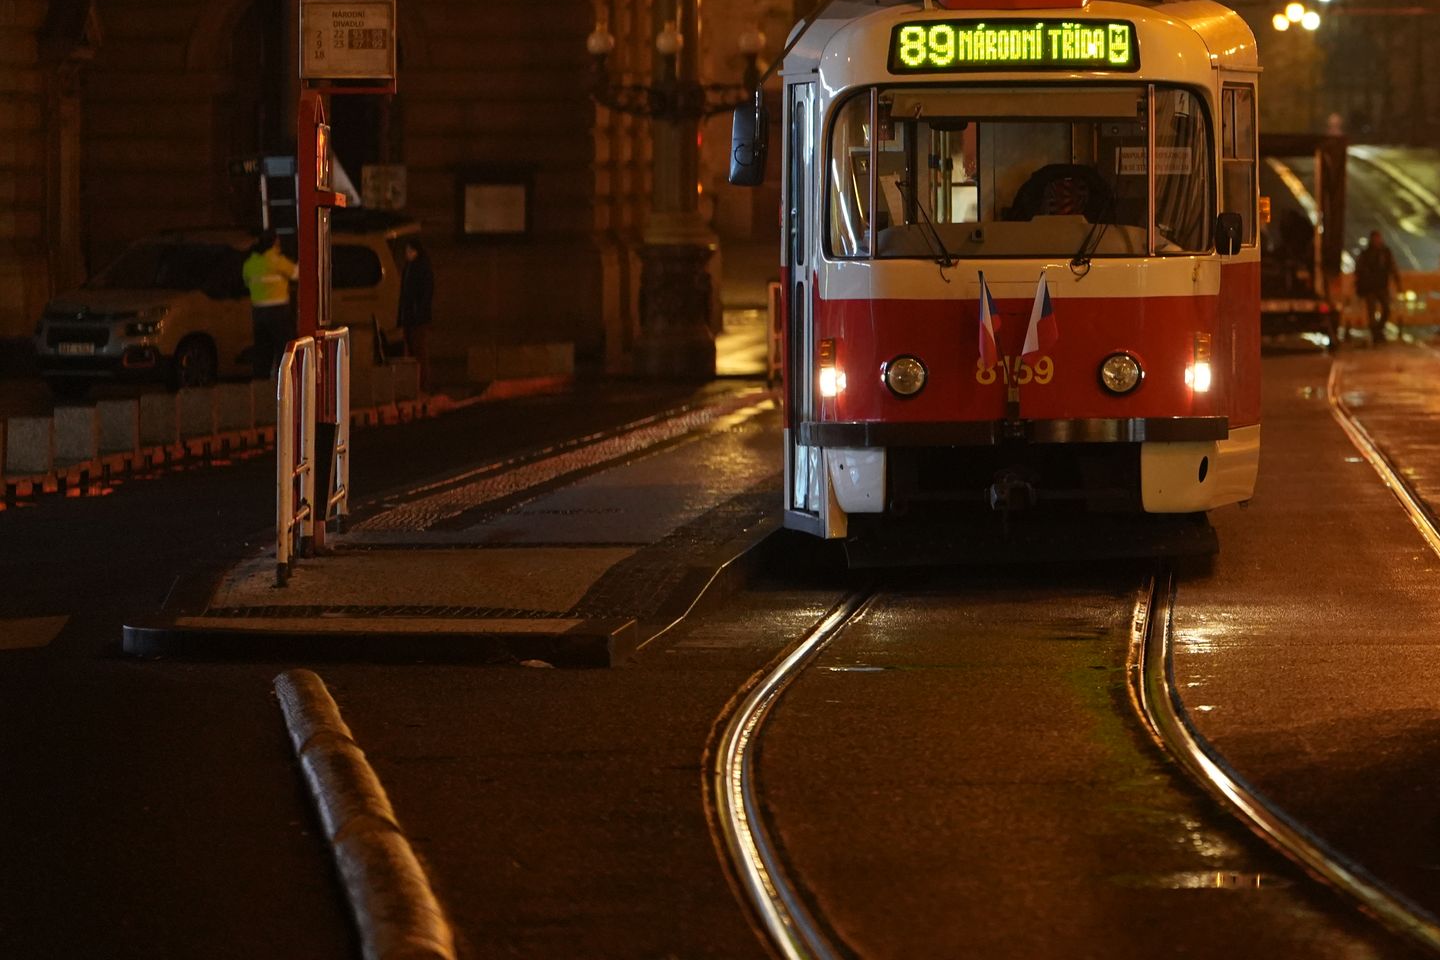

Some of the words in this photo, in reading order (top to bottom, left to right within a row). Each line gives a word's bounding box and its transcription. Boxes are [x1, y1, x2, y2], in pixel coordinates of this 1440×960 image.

[333, 20, 364, 28] DIVADLO
[316, 30, 322, 39] 2
[334, 30, 344, 39] 22
[316, 40, 322, 50] 9
[334, 40, 344, 49] 23
[900, 24, 955, 66] 89
[959, 22, 1044, 61] NÁRODNÍ
[1048, 22, 1104, 60] TŘÍDA
